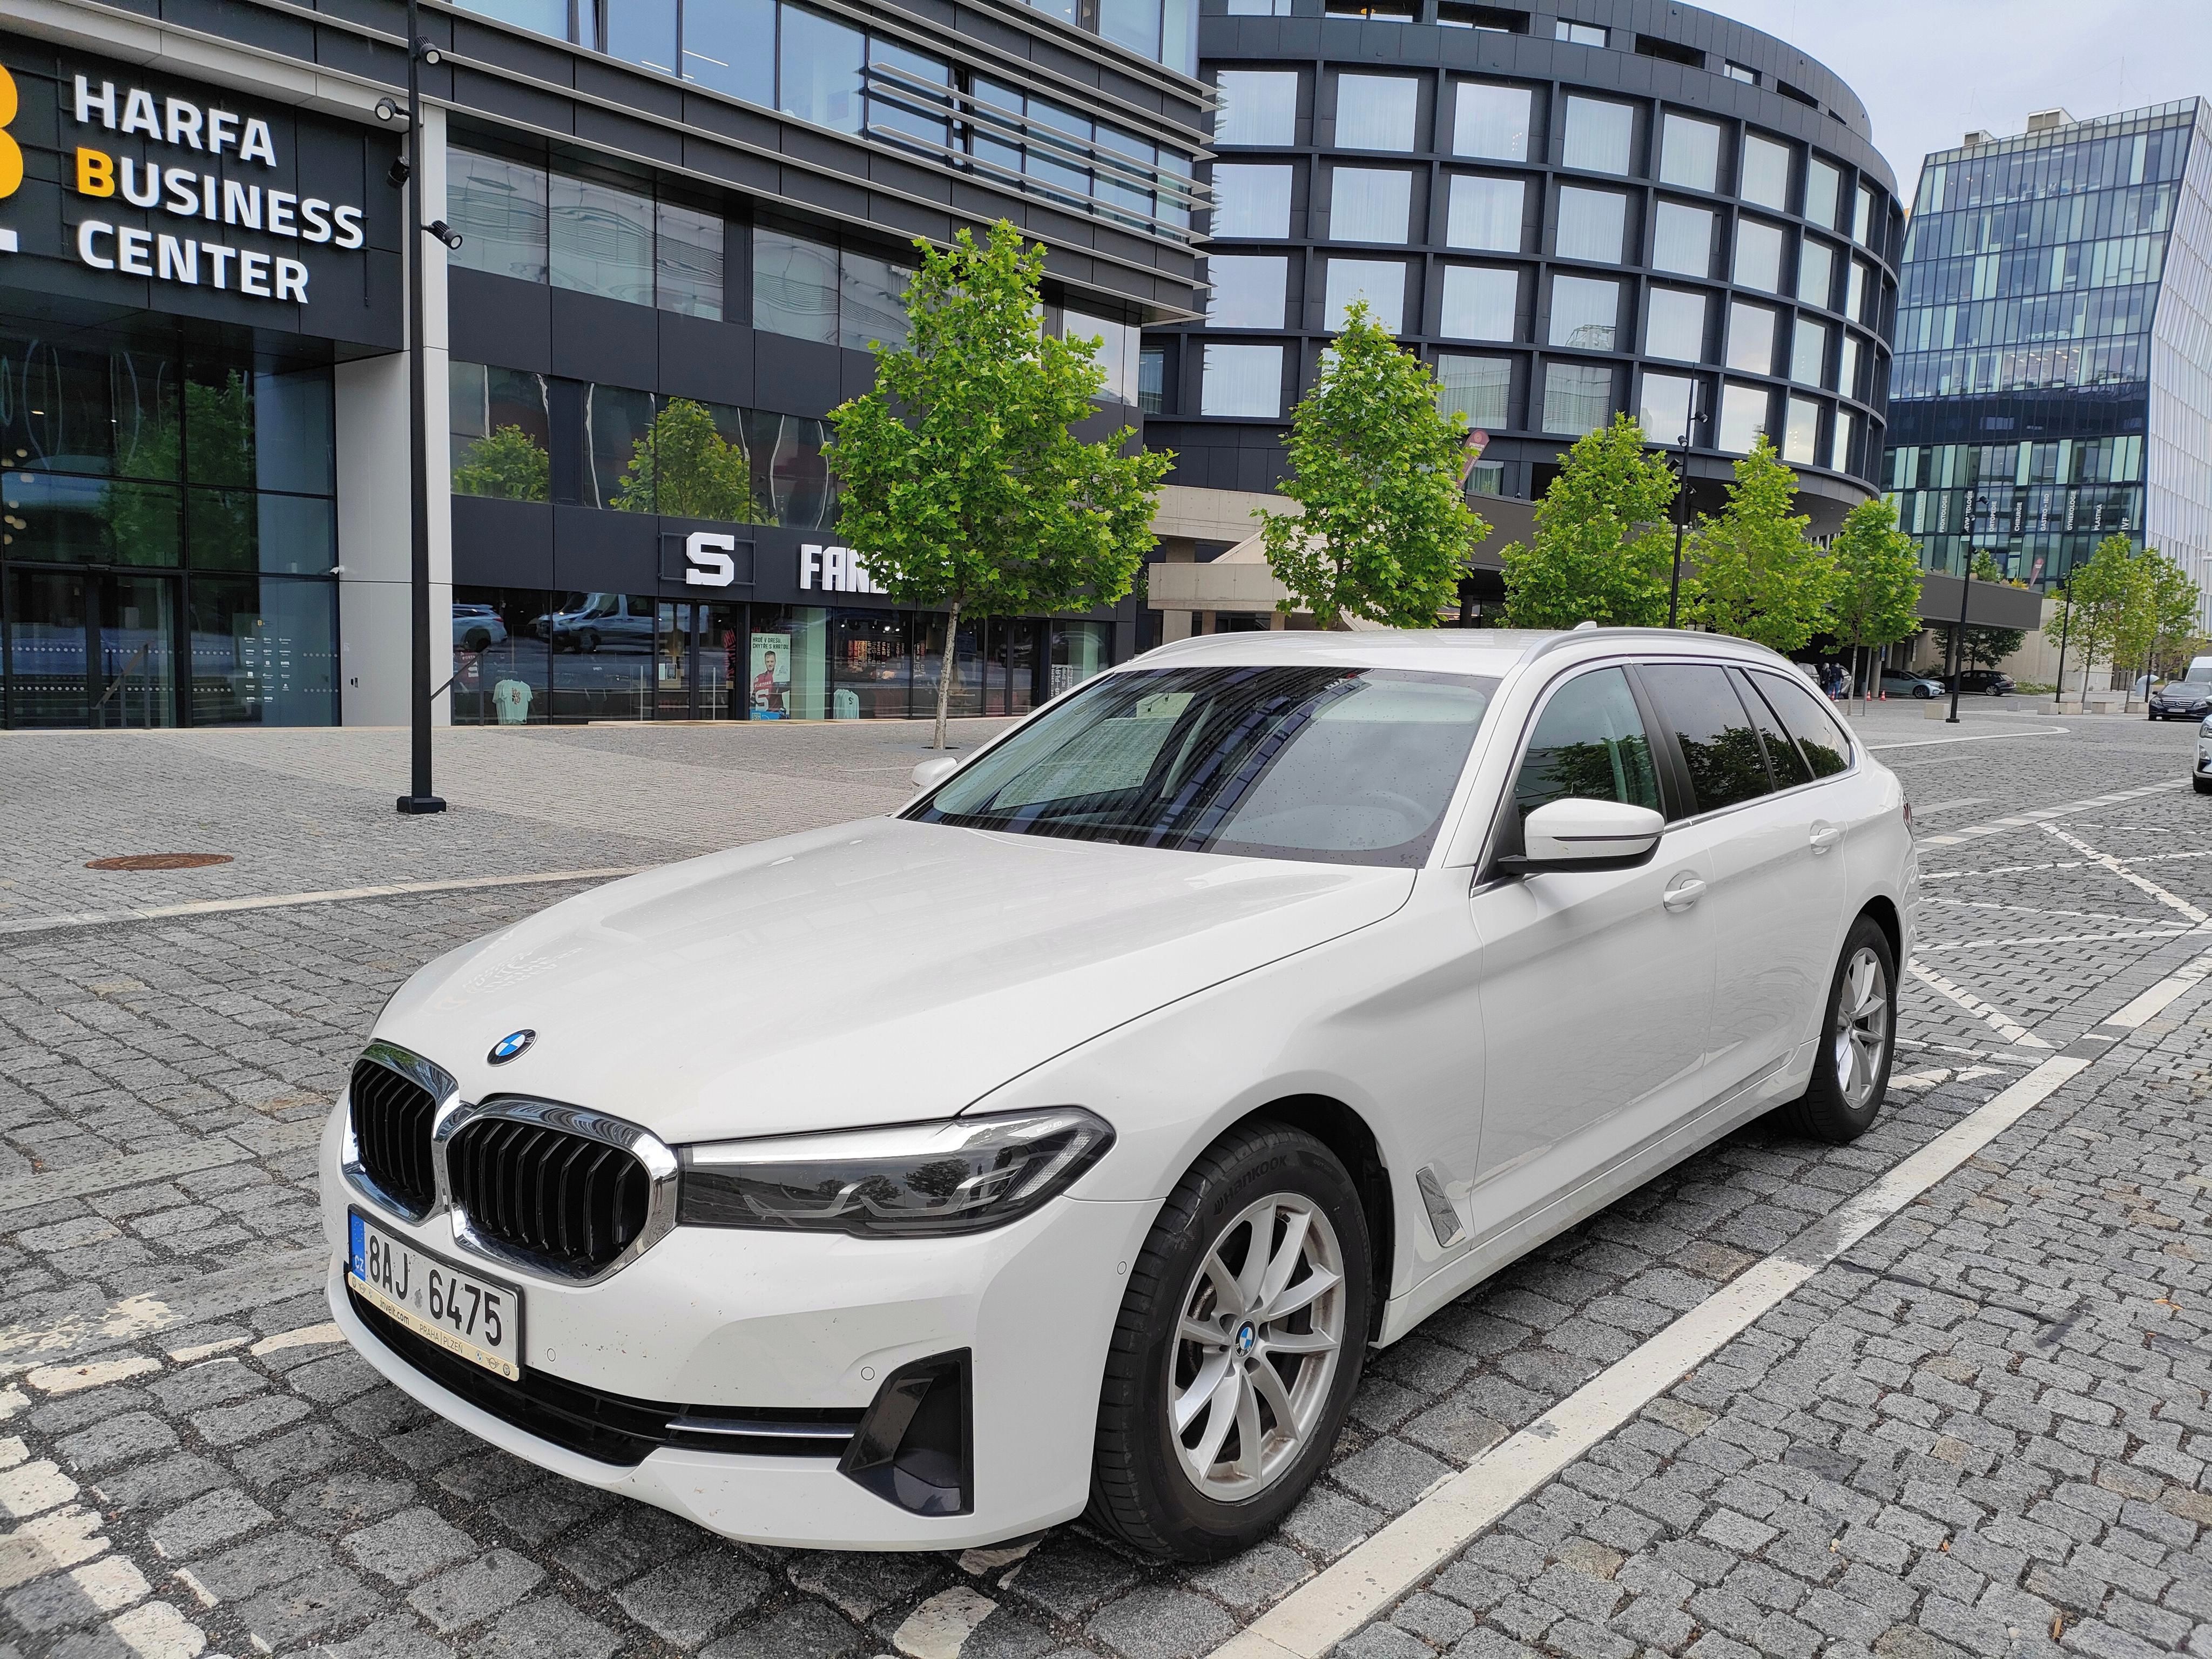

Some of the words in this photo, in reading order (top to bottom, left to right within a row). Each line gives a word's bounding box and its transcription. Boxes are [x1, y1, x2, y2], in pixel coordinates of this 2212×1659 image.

[75, 74, 276, 167] HARFA
[77, 147, 364, 249] BUSINESS
[78, 220, 308, 304] CENTER
[1939, 495, 1948, 533] PROKTOLOGIE
[1963, 490, 1973, 533] EVMTOLOGIE
[1989, 501, 1997, 532] ORTOPEDIE
[2014, 502, 2022, 532] CHIRURGIE
[2040, 509, 2048, 531] GASTRO
[2067, 490, 2076, 531] GYNEKOLOGIE
[2093, 503, 2102, 531] PLASTIKA
[2121, 517, 2130, 530] IVF
[686, 532, 734, 586] S
[355, 1255, 364, 1272] CZ
[369, 1235, 408, 1300] 8AJ
[429, 1269, 502, 1347] 6475
[380, 1297, 409, 1325] invelt.com
[420, 1324, 440, 1342] PRAHA
[443, 1336, 463, 1353] PLZEŇ
